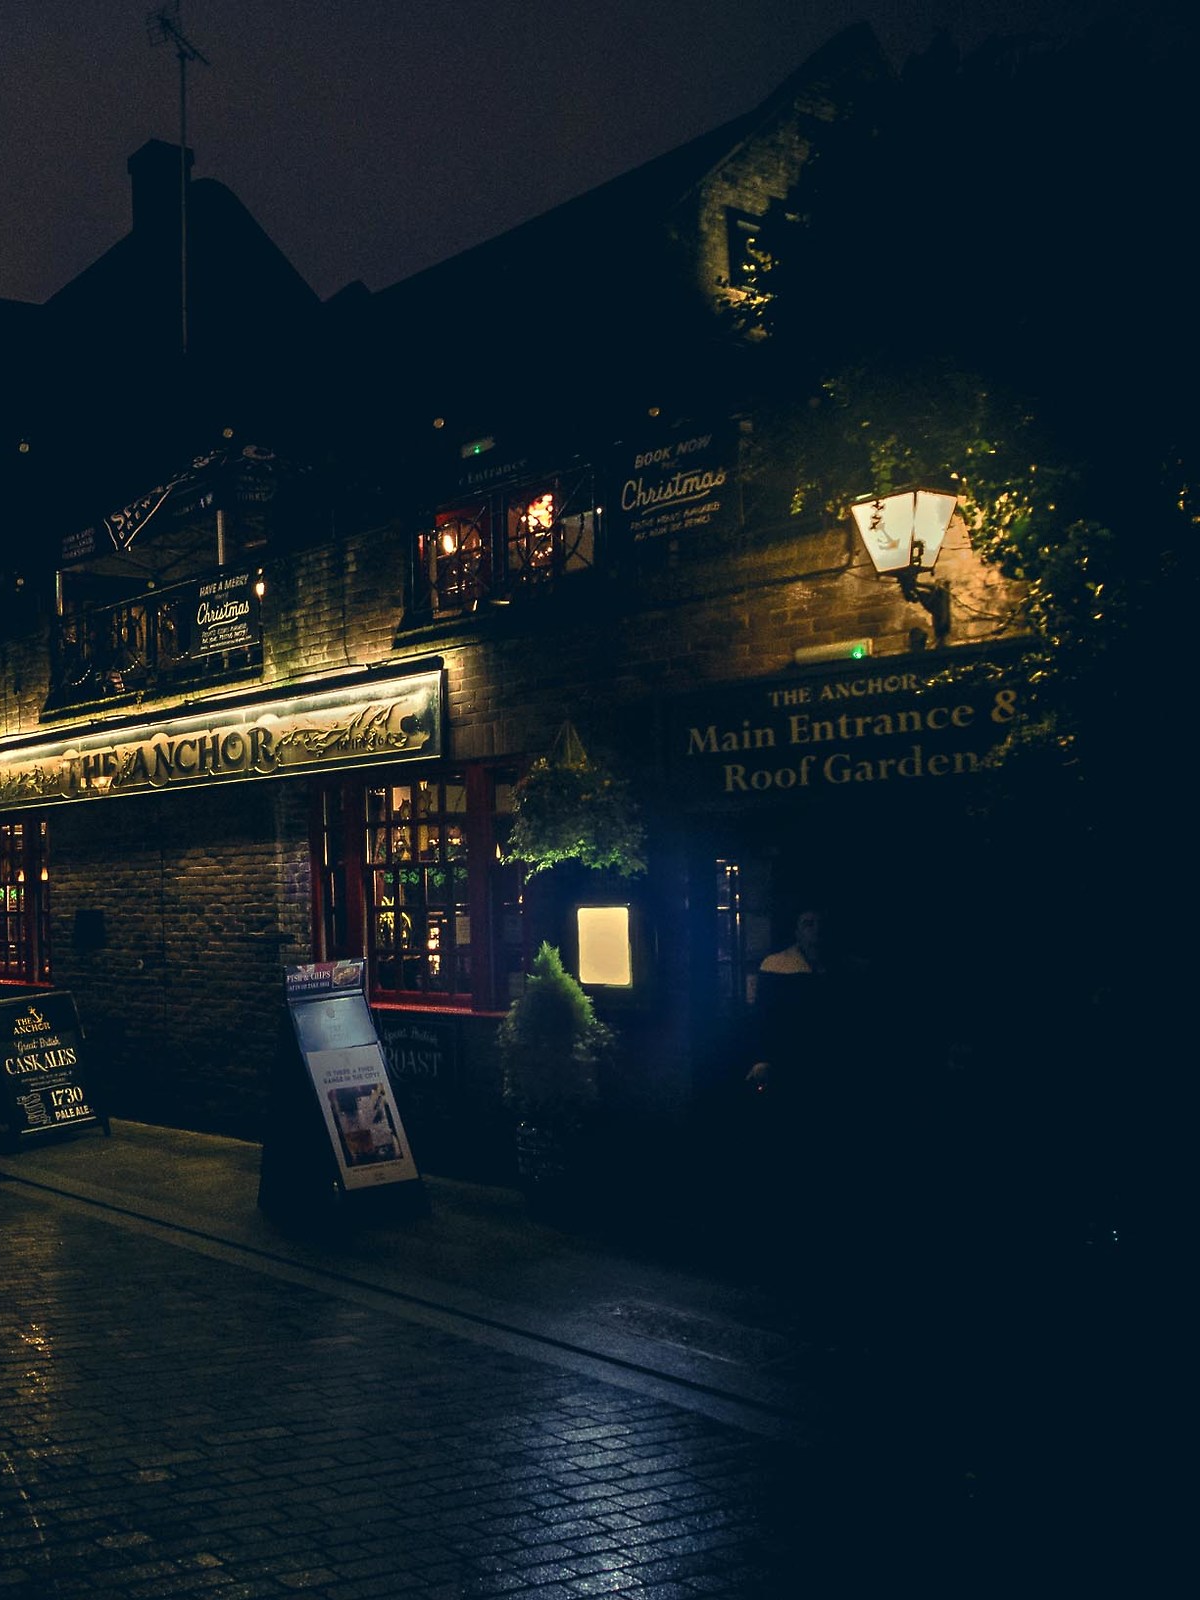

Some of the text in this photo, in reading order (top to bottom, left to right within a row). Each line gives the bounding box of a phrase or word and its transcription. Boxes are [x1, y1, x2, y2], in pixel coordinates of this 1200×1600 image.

[634, 446, 673, 469] BOOK
[676, 433, 712, 455] NOW
[622, 466, 726, 510] Christmas
[199, 583, 217, 597] HAVE
[217, 581, 223, 591] A
[225, 574, 249, 590] MERRY
[197, 600, 250, 625] Christmas
[768, 674, 919, 707] THE ANCHOR
[686, 690, 1018, 755] Main Entrance &
[65, 726, 280, 786] THE ANCHOR
[722, 755, 816, 792] Roof
[310, 970, 331, 980] CHIPS
[13, 1022, 51, 1035] ANCHOR
[15, 1017, 32, 1026] THE
[5, 1048, 77, 1075] CASK ALES
[384, 1046, 443, 1080] ROAST
[50, 1086, 83, 1106] 1730
[54, 1108, 75, 1120] PALE
[75, 1105, 90, 1116] ALE
